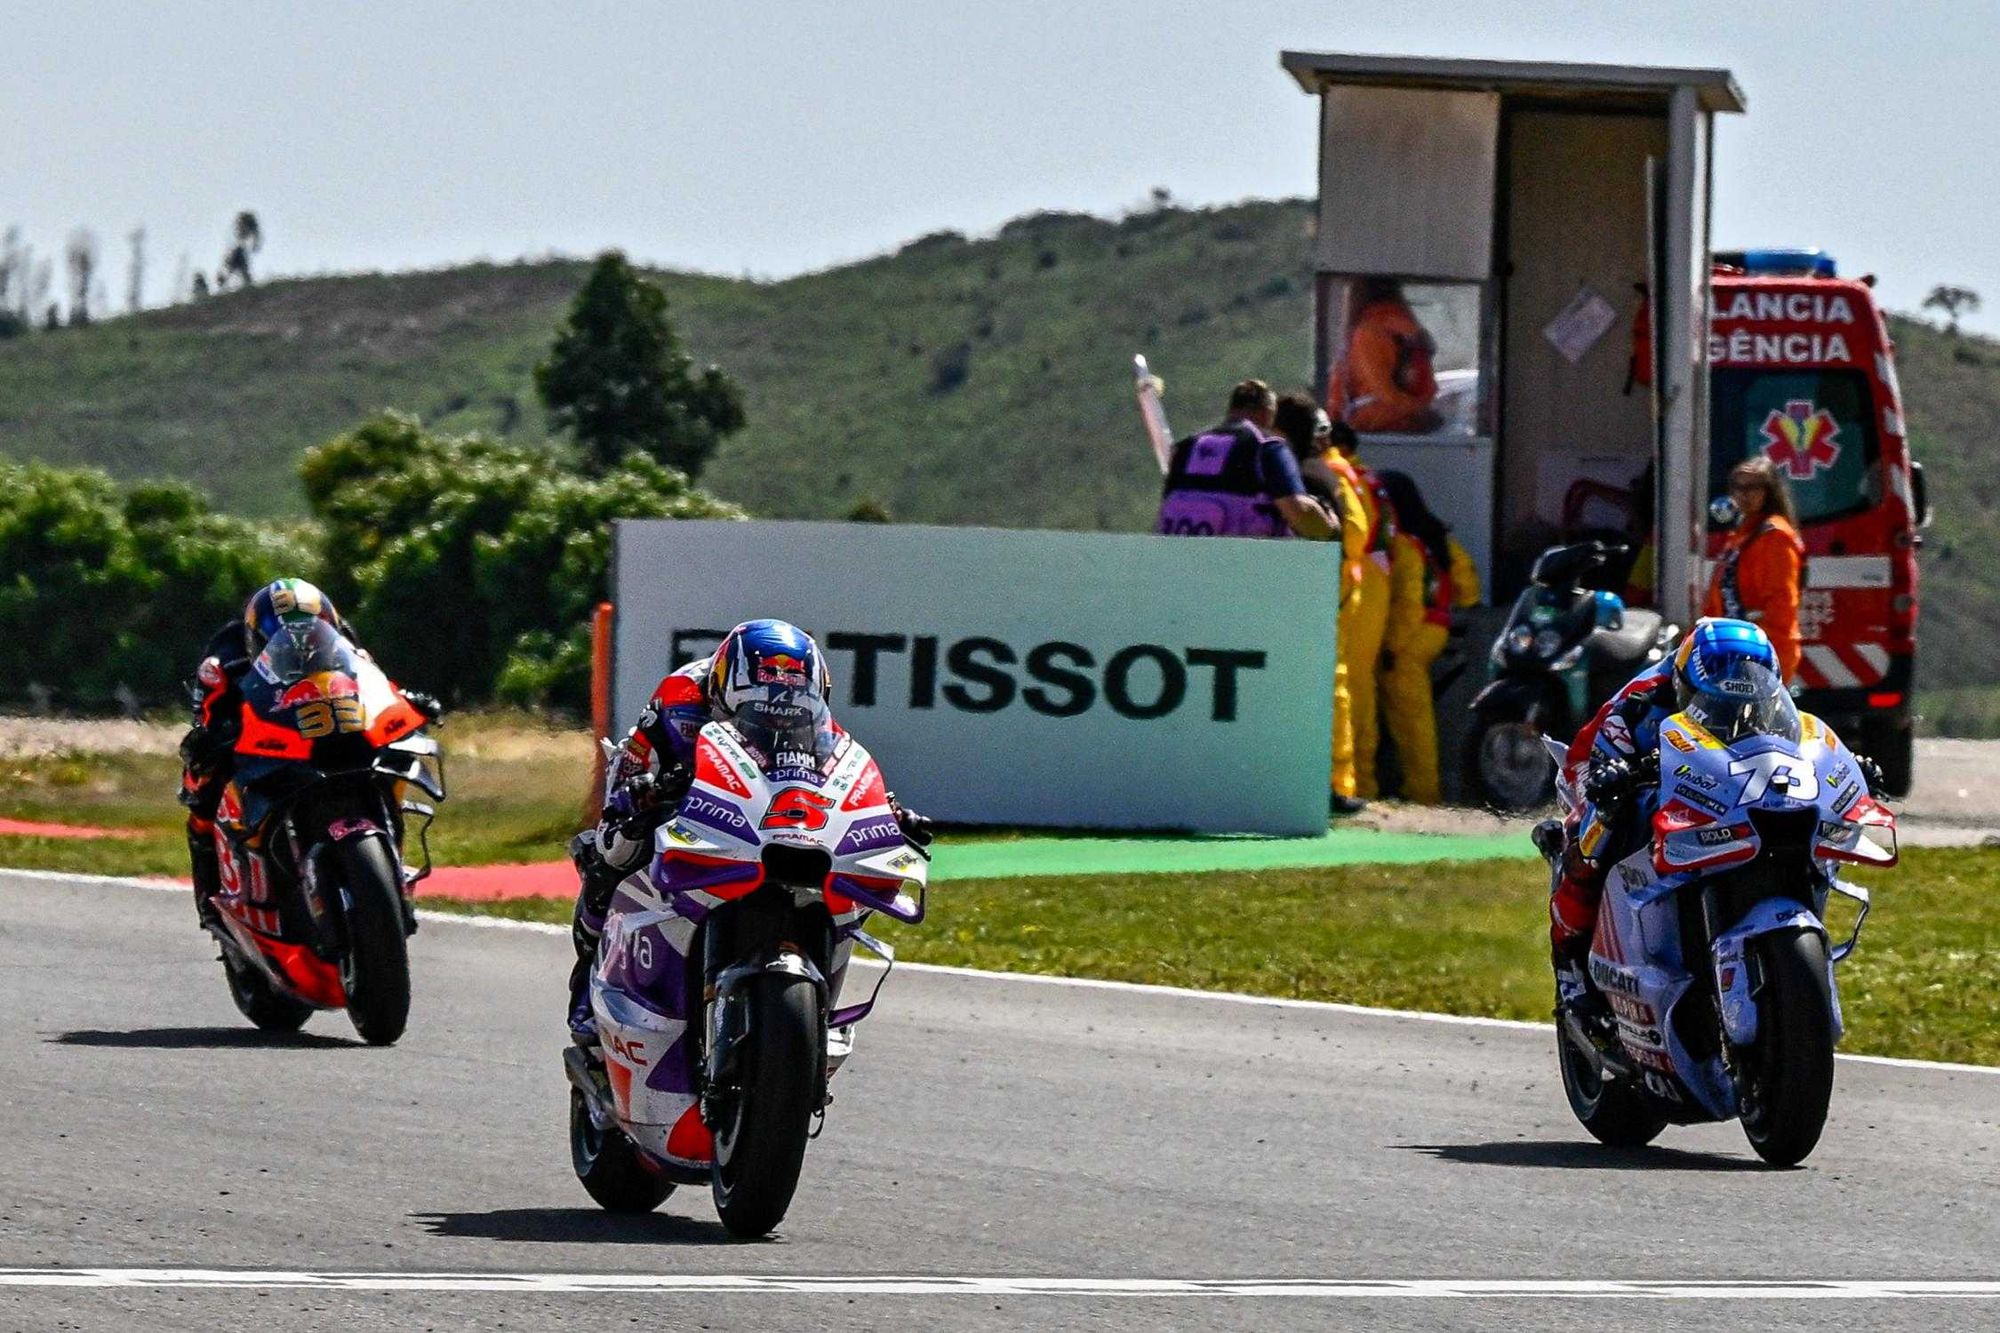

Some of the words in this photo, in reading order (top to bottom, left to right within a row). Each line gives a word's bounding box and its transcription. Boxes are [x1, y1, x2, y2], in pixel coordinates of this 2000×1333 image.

[827, 632, 1266, 724] TISSOT
[753, 702, 804, 717] SHARK
[700, 743, 743, 791] PRAMAC
[775, 750, 816, 770] FIAMM
[776, 766, 820, 785] prima
[1727, 749, 1821, 809] 73
[683, 796, 747, 829] prima
[757, 785, 837, 832] 5
[773, 833, 825, 846] PRAMAC
[846, 821, 901, 847] prima
